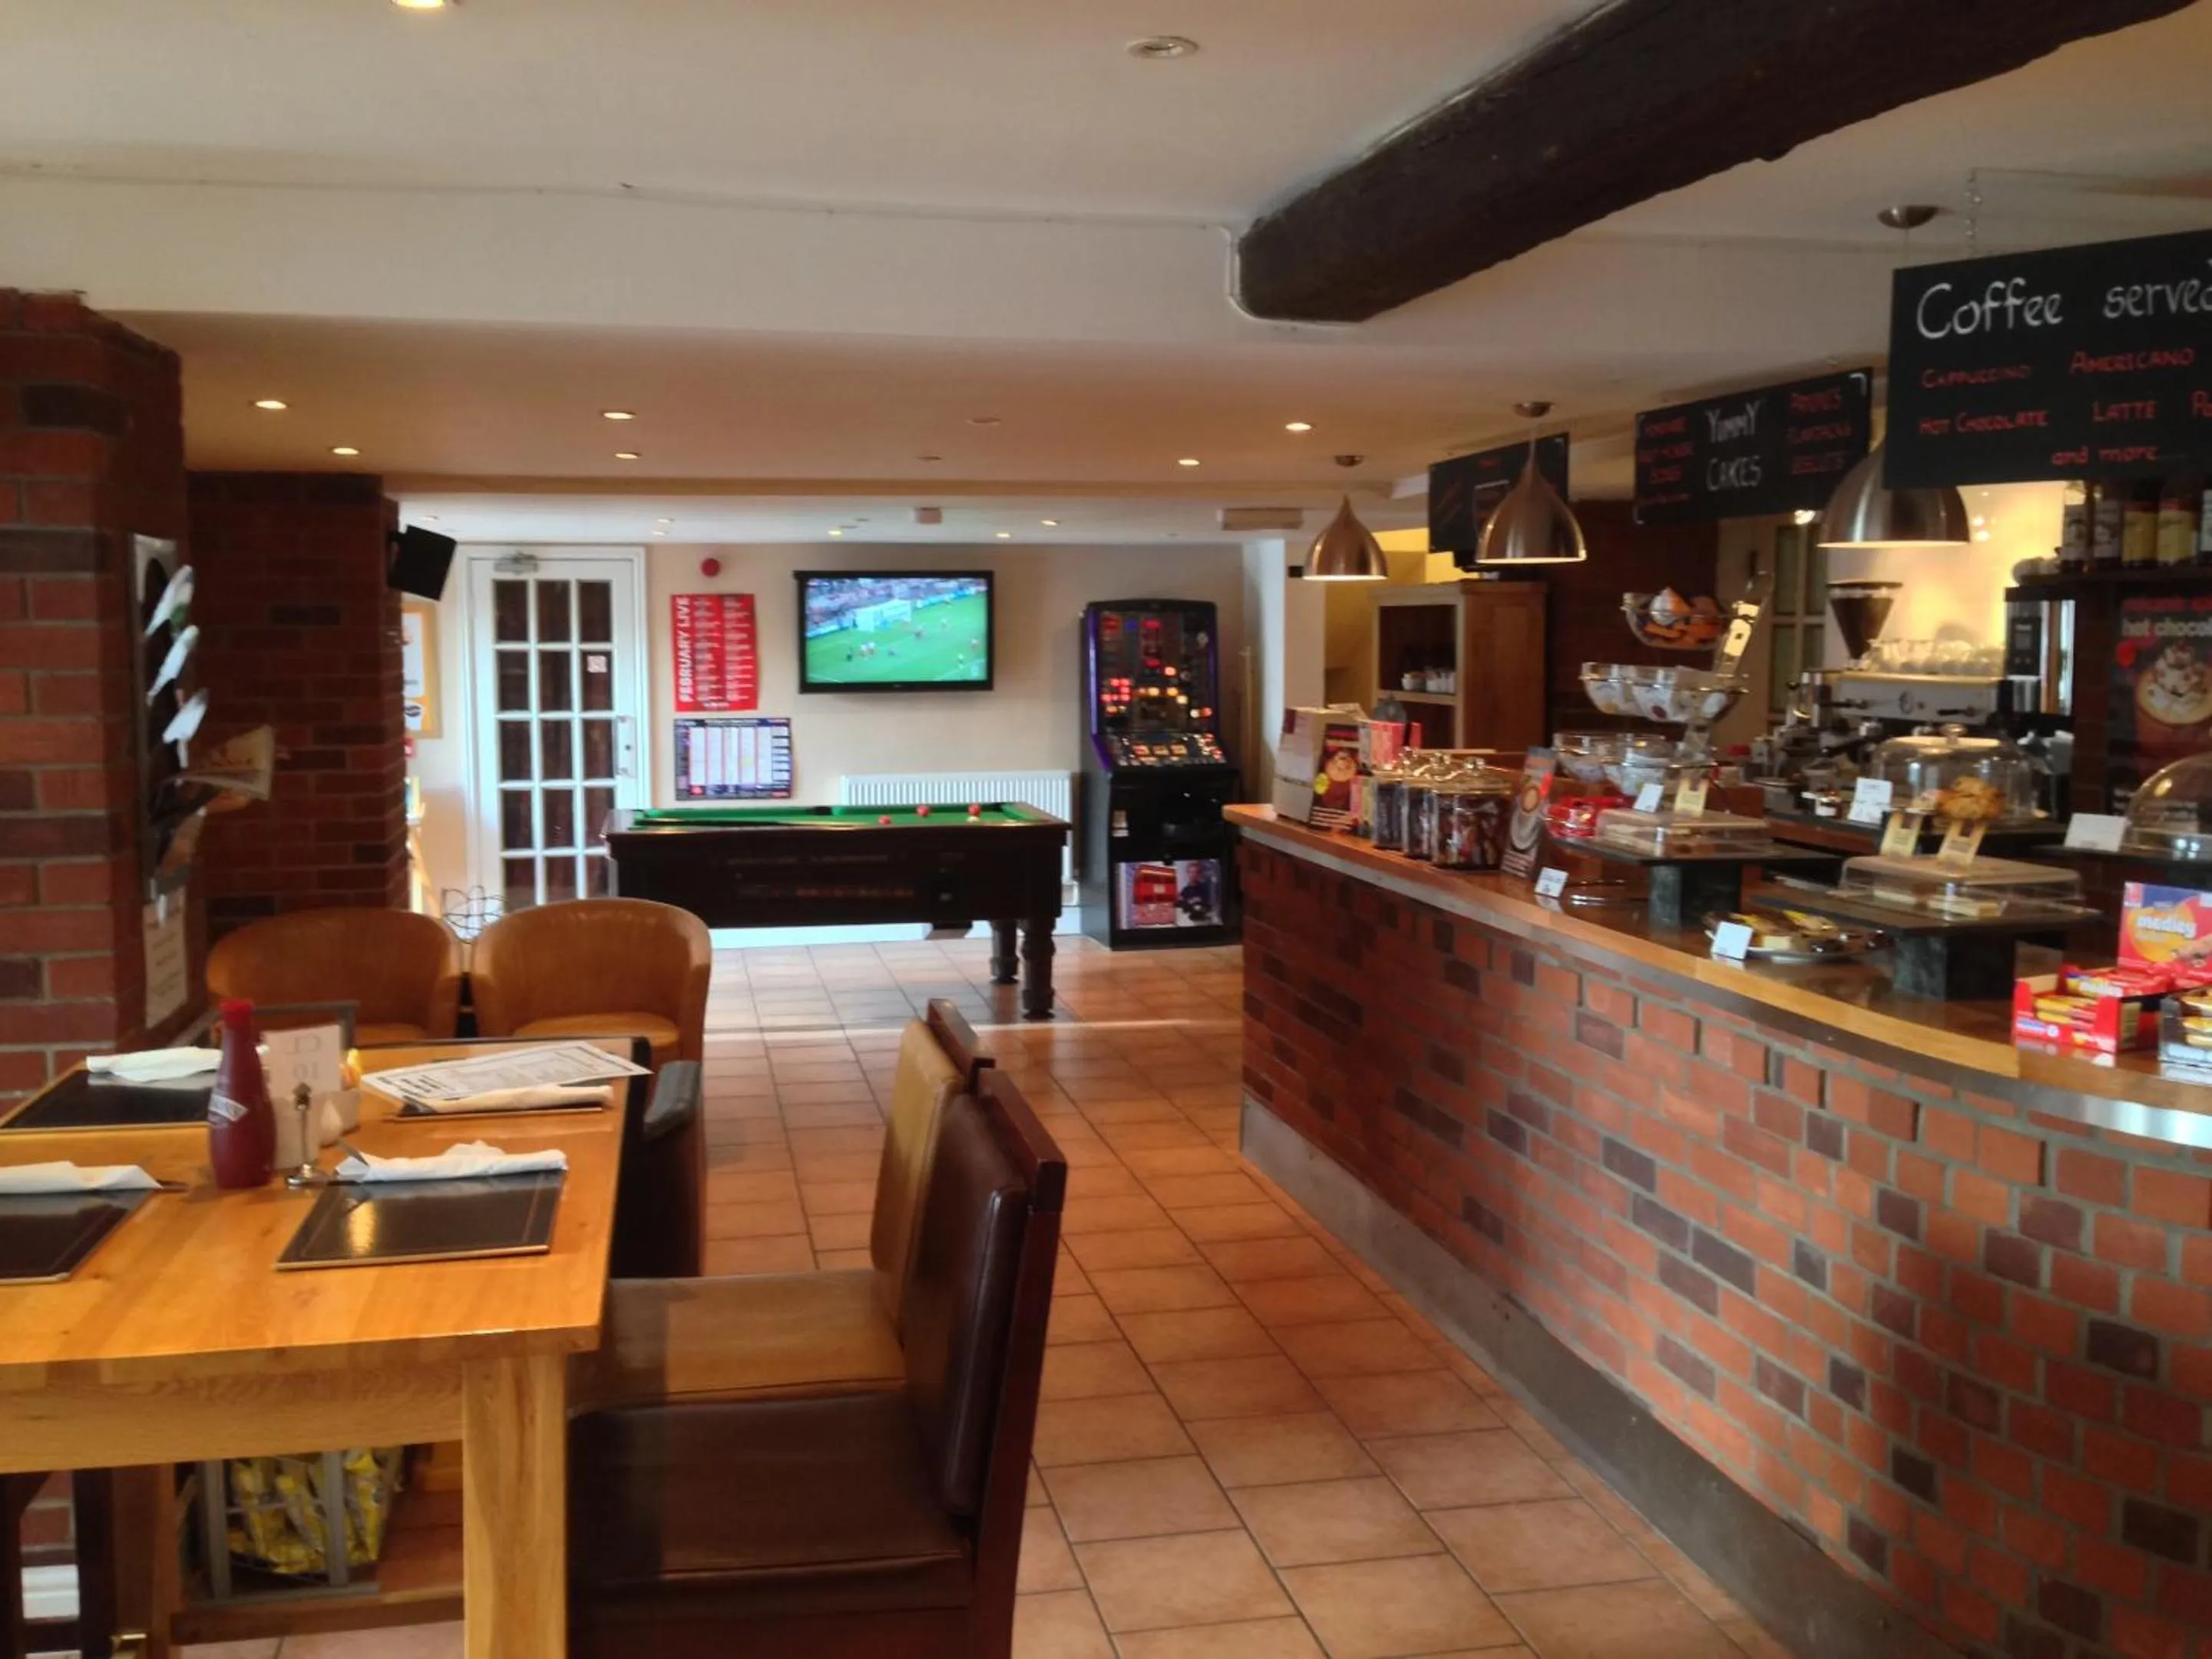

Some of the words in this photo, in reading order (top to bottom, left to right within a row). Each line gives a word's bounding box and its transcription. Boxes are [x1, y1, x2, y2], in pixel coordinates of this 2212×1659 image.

[1916, 278, 2063, 339] Coffee
[1706, 455, 1763, 491] CAKES
[676, 596, 691, 627] LIVE
[677, 630, 693, 702] FEBRUARY
